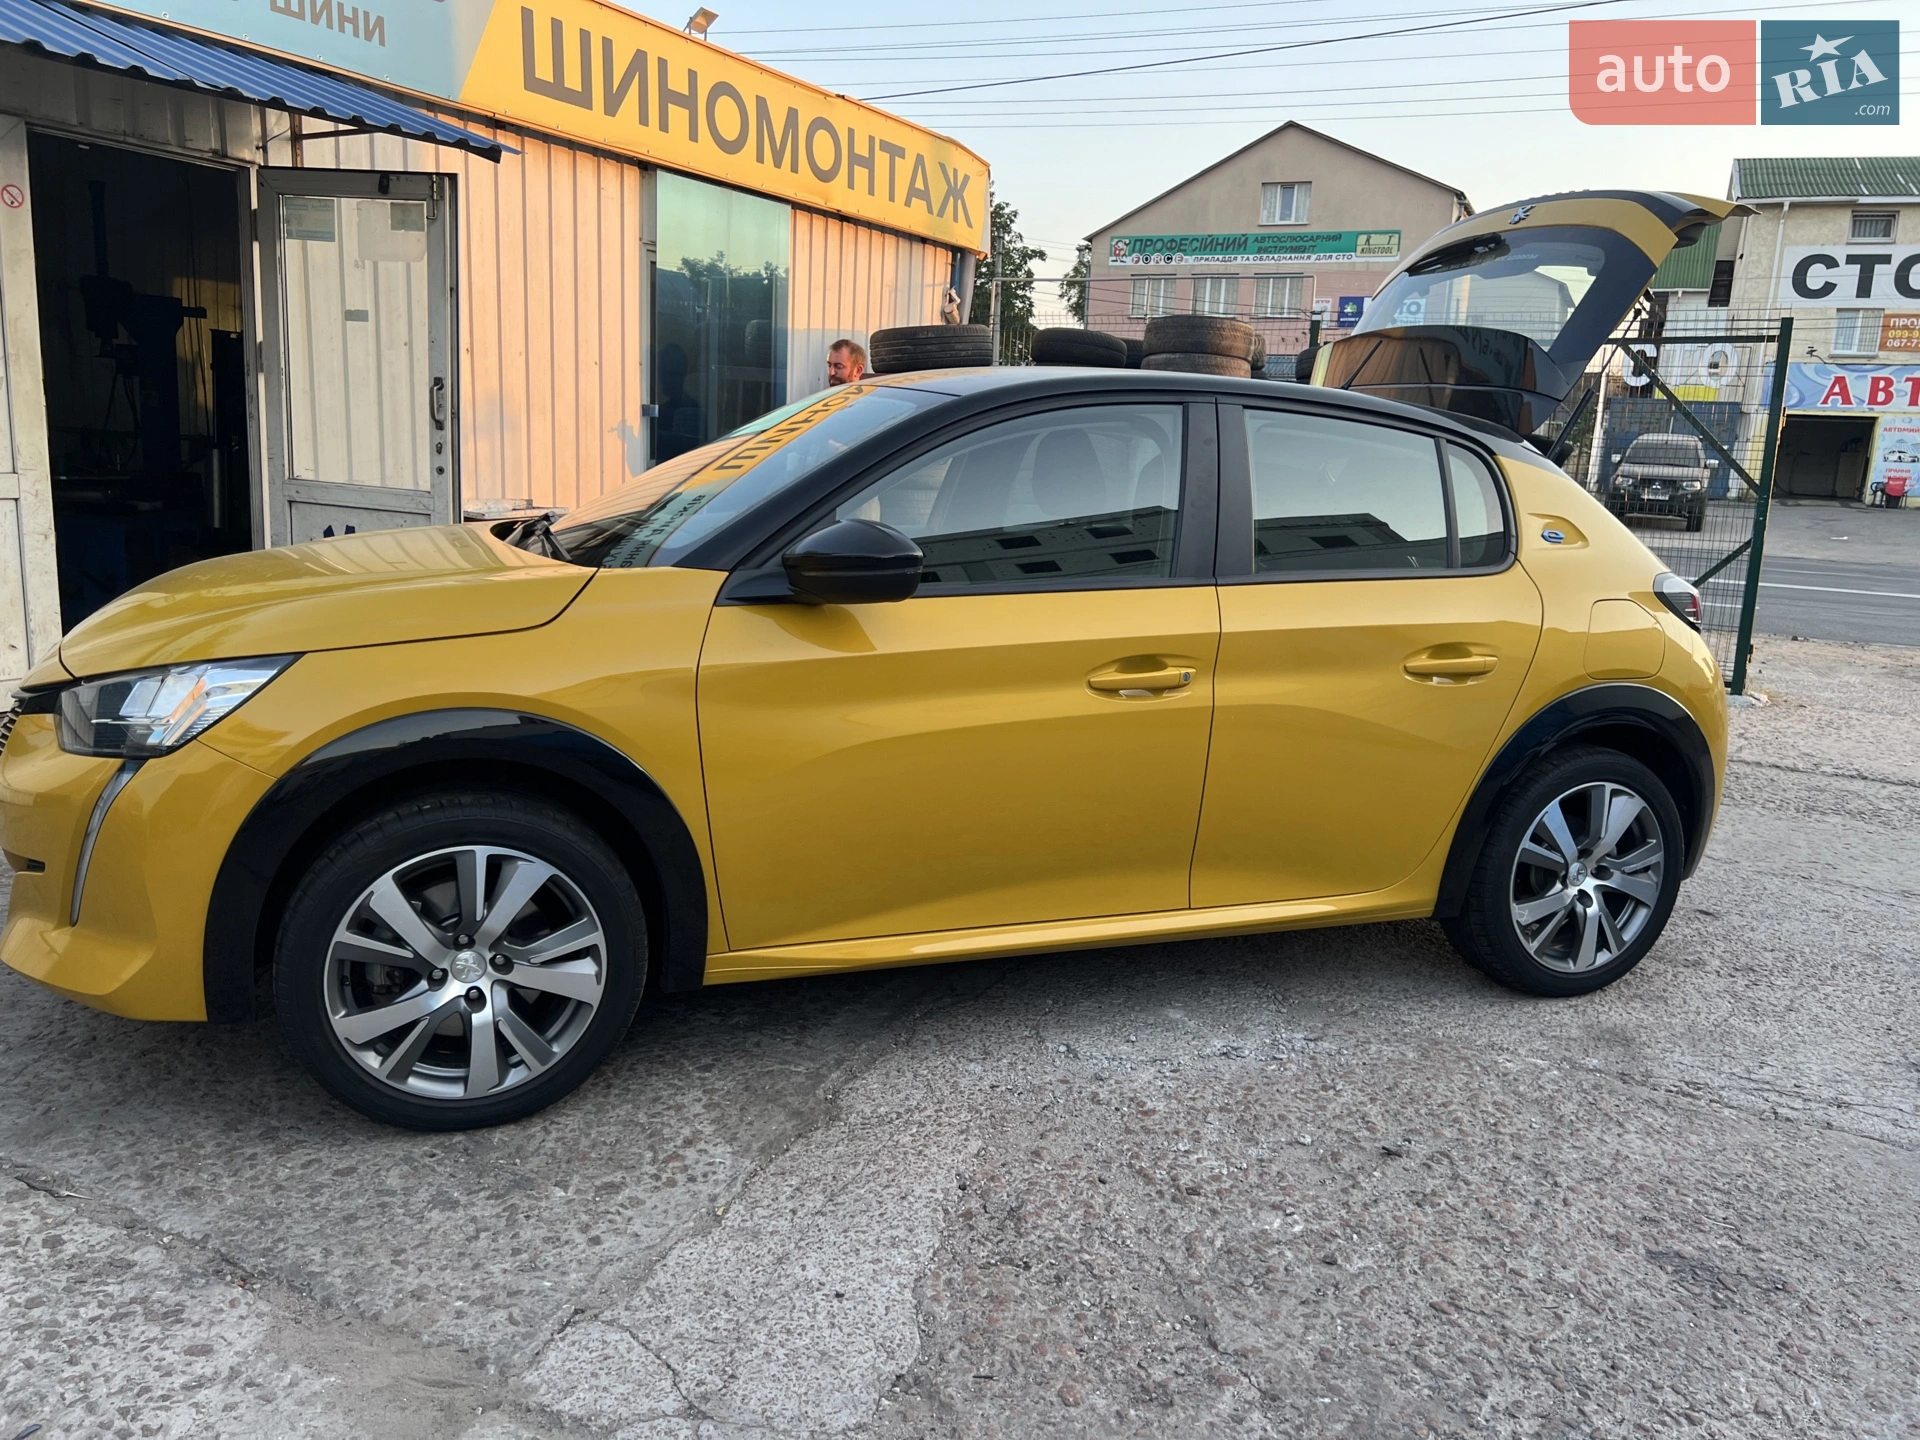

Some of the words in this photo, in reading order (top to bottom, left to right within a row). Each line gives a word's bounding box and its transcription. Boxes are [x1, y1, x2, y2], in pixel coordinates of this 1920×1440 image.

[520, 5, 974, 230] ШИНОМОНТАЖ
[1132, 233, 1249, 253] ПРОФЕСІЙНИЙ
[1252, 233, 1342, 244] АВТОСЛЮСАРНИЙ
[1256, 244, 1318, 254] ІНСТРУМЕНТ
[1360, 246, 1393, 255] KINGTOOL
[1131, 253, 1184, 264] FORCE
[1193, 255, 1238, 263] ПРИЛАДДЯ
[1252, 254, 1311, 262] ОБЛАДНАННЯ
[1314, 254, 1333, 262] ДЛЯ
[1335, 253, 1353, 261] СТО
[1888, 329, 1920, 339] 099-9
[1886, 338, 1920, 348] 067-7
[1622, 342, 1739, 388] СТО
[1820, 376, 1920, 407] АВТ
